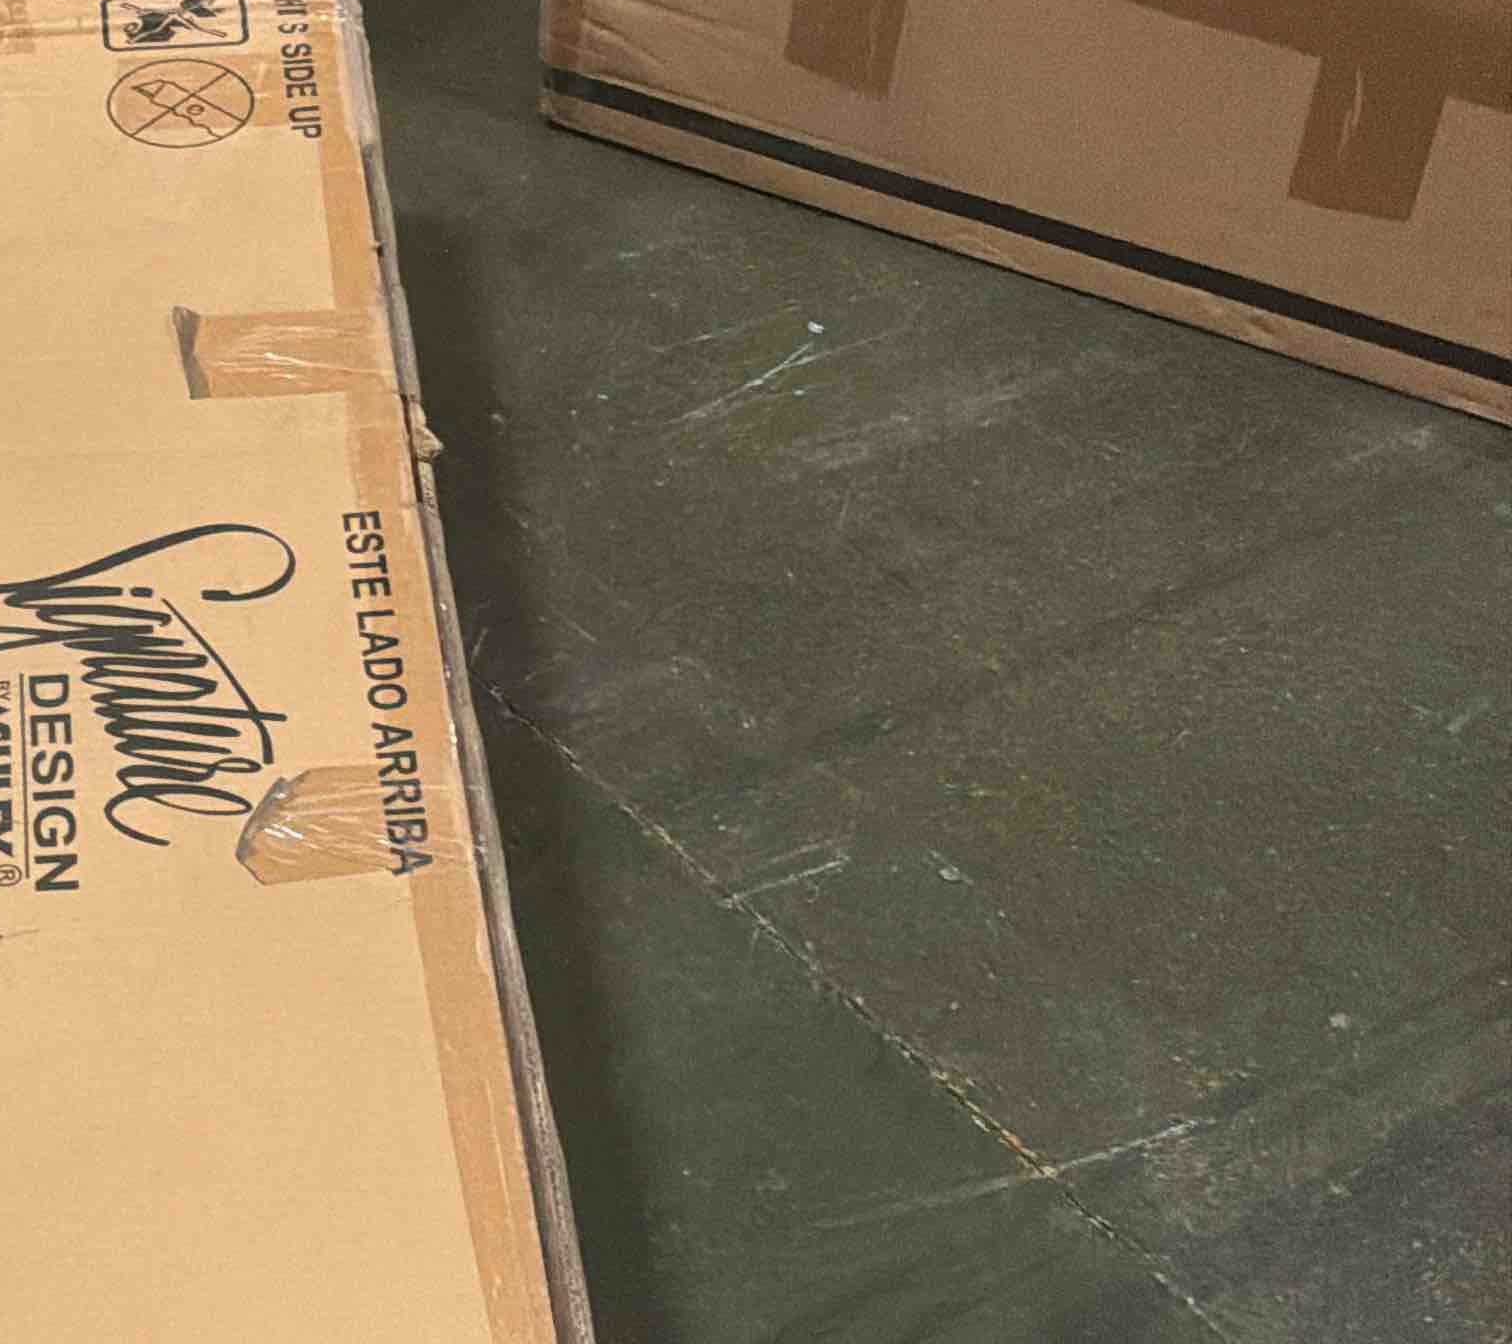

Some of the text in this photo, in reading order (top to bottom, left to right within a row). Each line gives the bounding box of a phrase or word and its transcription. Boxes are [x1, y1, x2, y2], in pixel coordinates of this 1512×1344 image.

[280, 43, 319, 98] SIDE
[287, 104, 322, 139] UP
[341, 509, 433, 876] ESTE LADO ARRIBA
[27, 673, 79, 892] DESIGN
